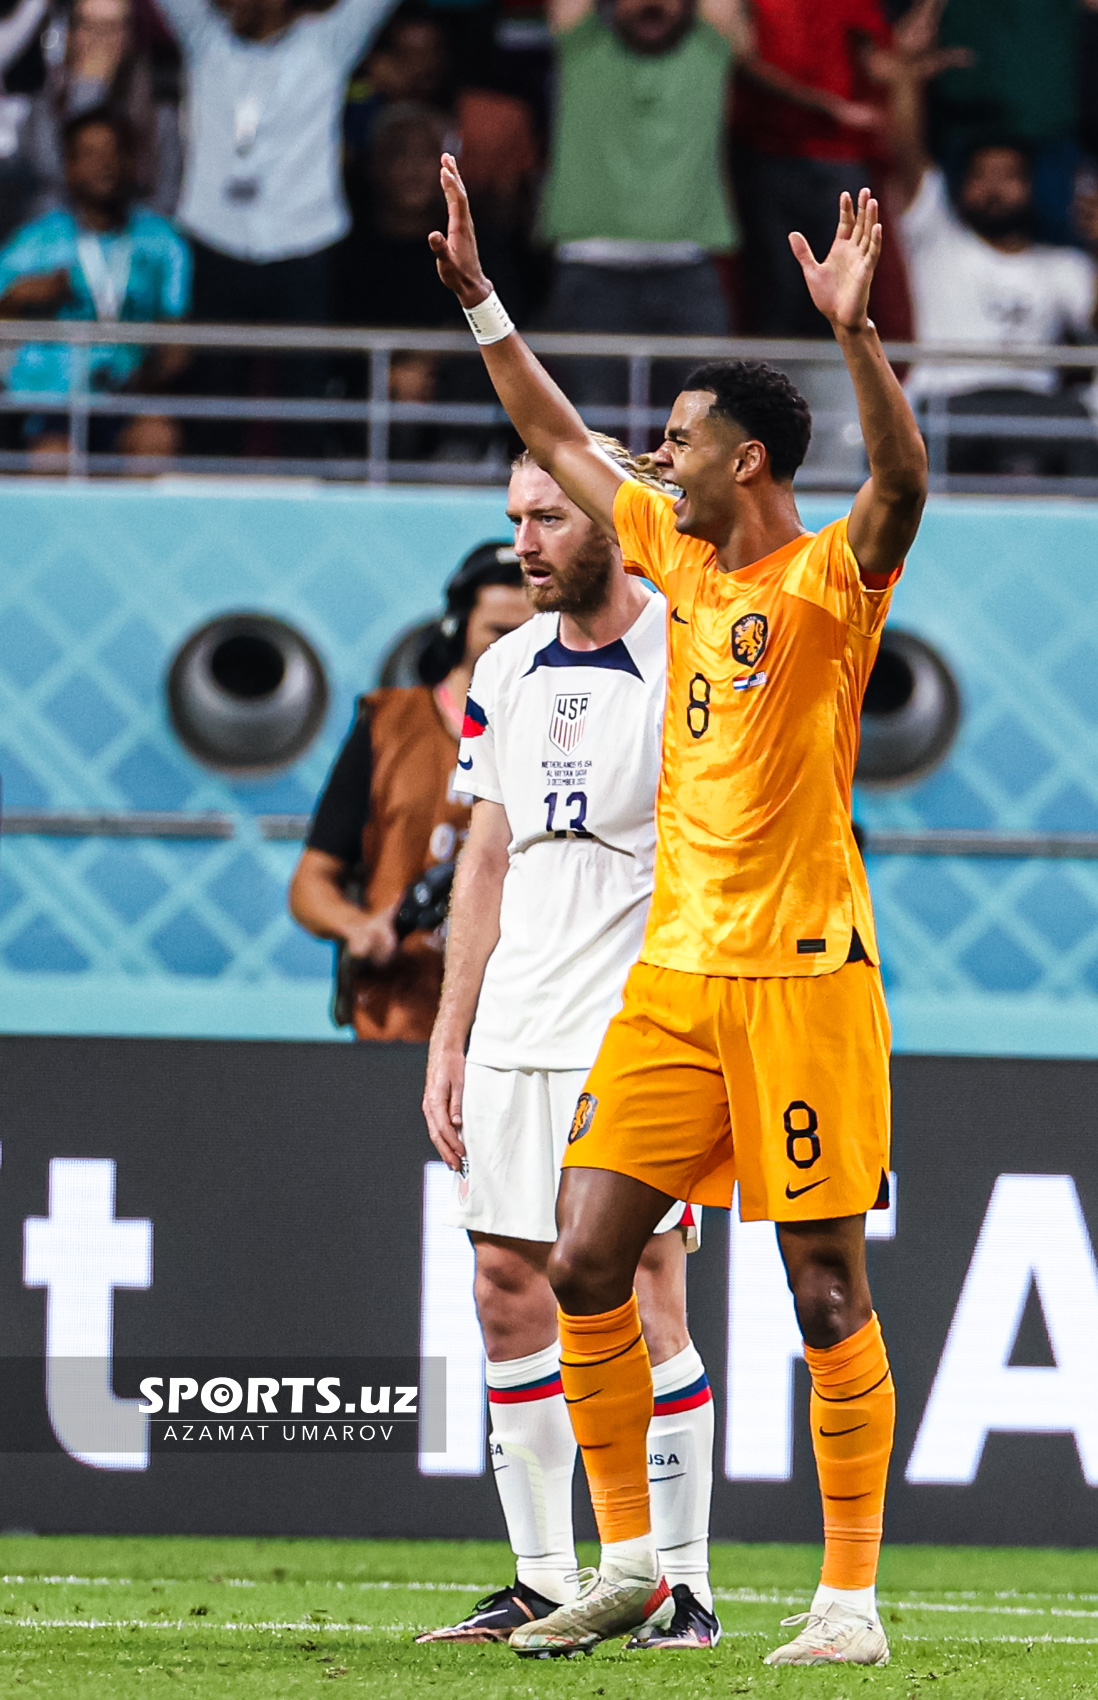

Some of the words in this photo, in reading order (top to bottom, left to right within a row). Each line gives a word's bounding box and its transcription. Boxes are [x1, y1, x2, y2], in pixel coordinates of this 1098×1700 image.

[558, 698, 588, 720] USA
[687, 672, 711, 739] 8
[544, 791, 594, 839] 13
[783, 1100, 821, 1169] 8
